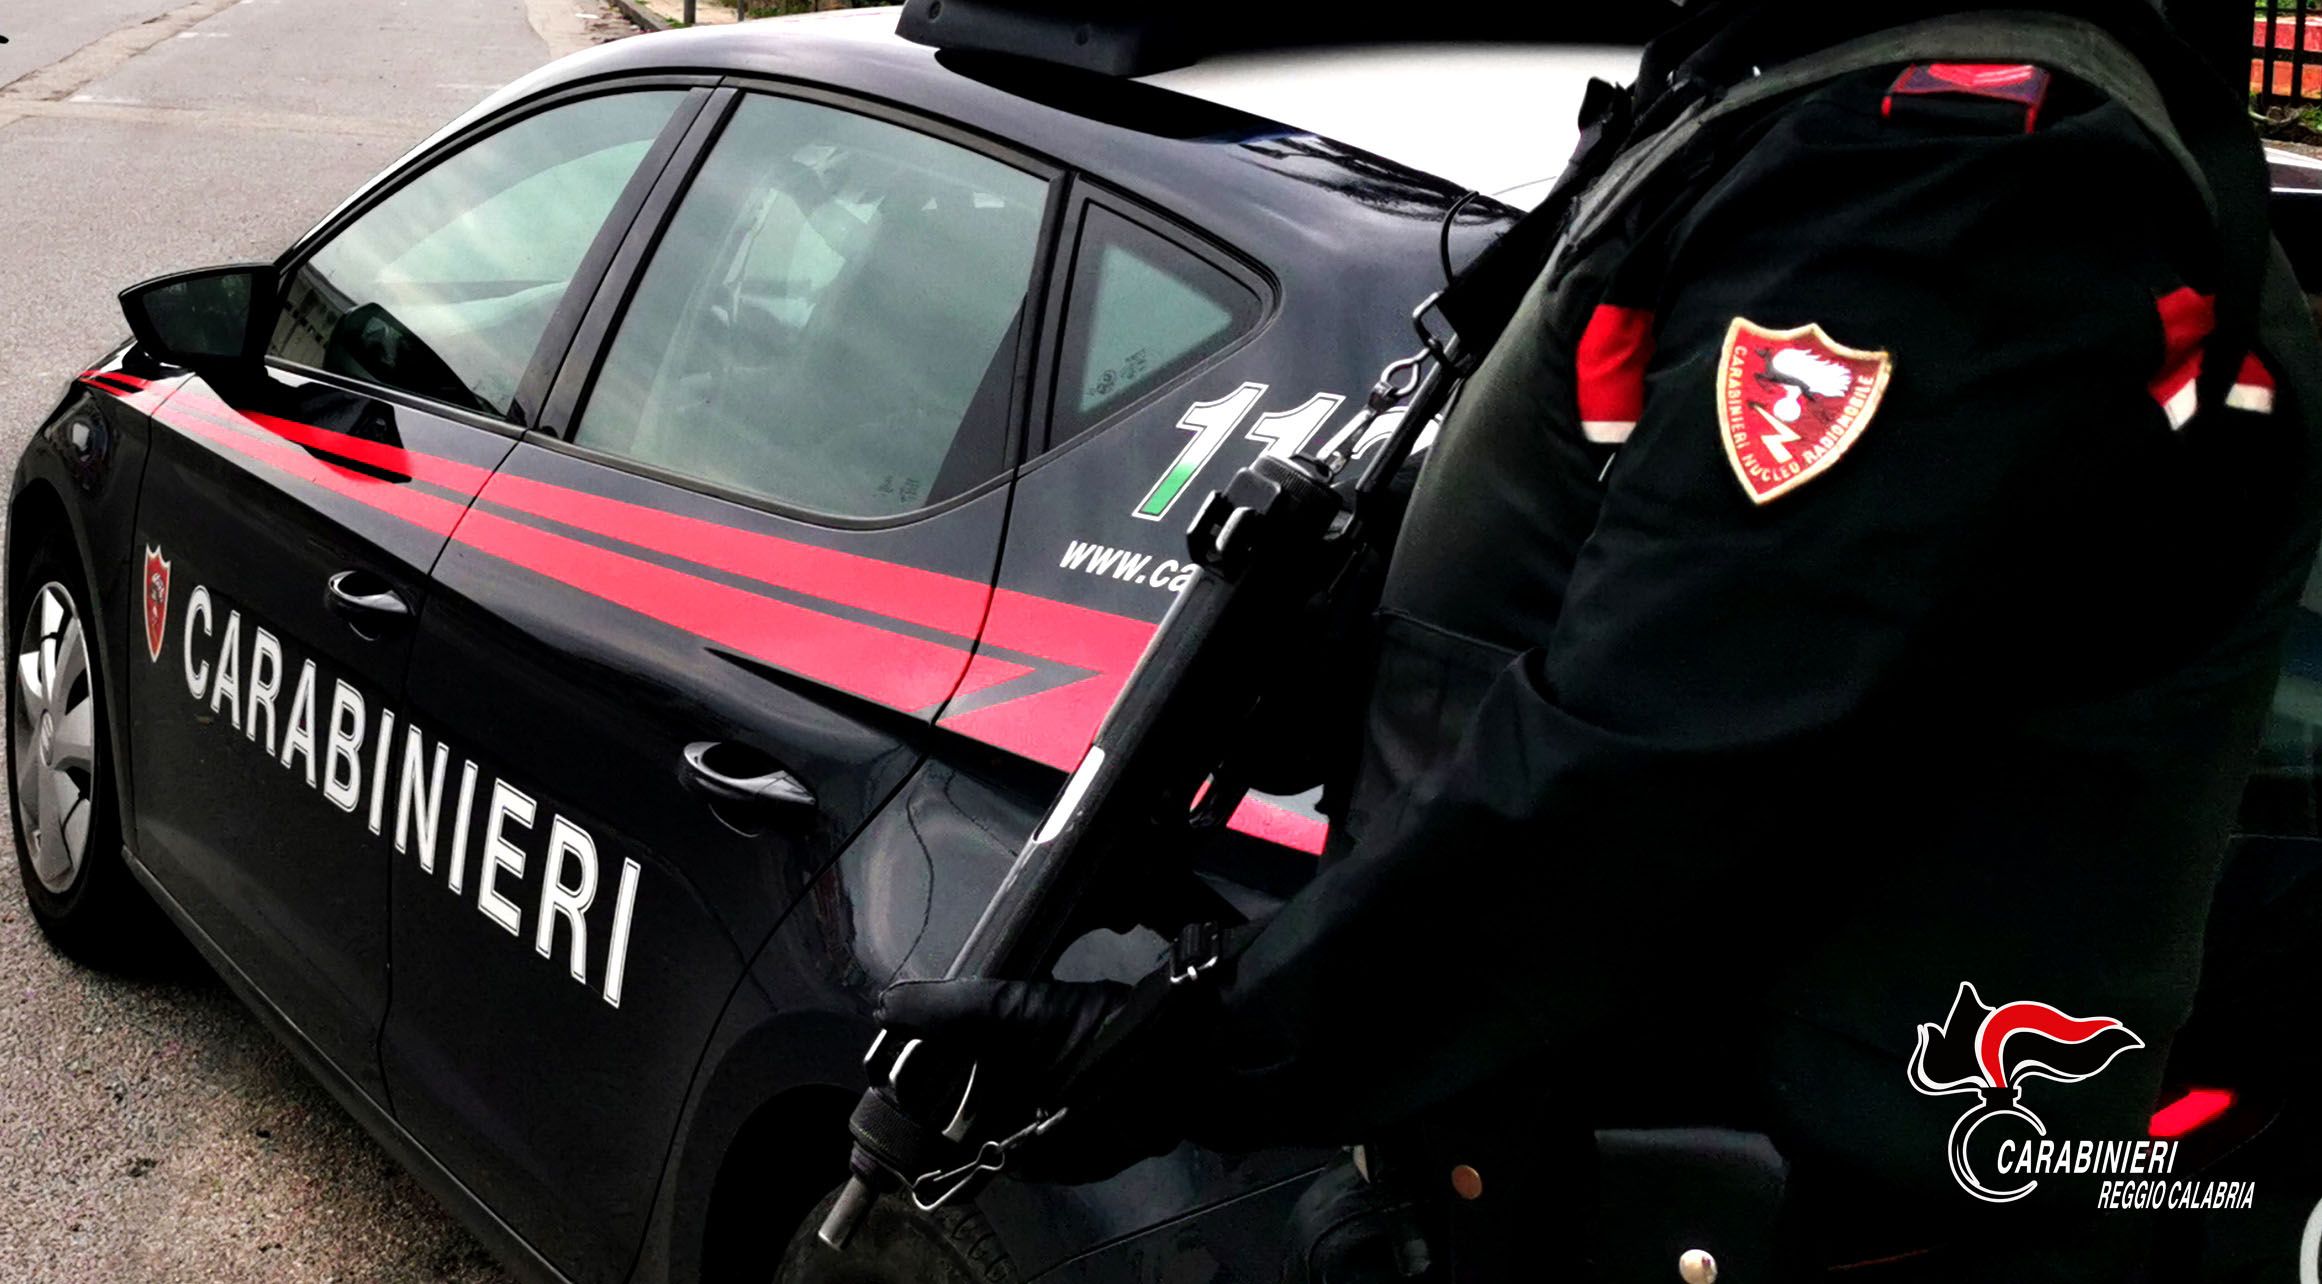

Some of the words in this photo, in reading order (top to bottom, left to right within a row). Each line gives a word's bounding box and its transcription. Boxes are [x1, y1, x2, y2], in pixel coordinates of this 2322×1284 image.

[1727, 345, 1752, 450] CARABINIERI
[1741, 453, 1801, 482] NUCLEO
[1802, 375, 1874, 465] RADIOMOBILE
[183, 584, 641, 1008] CARABINIERI
